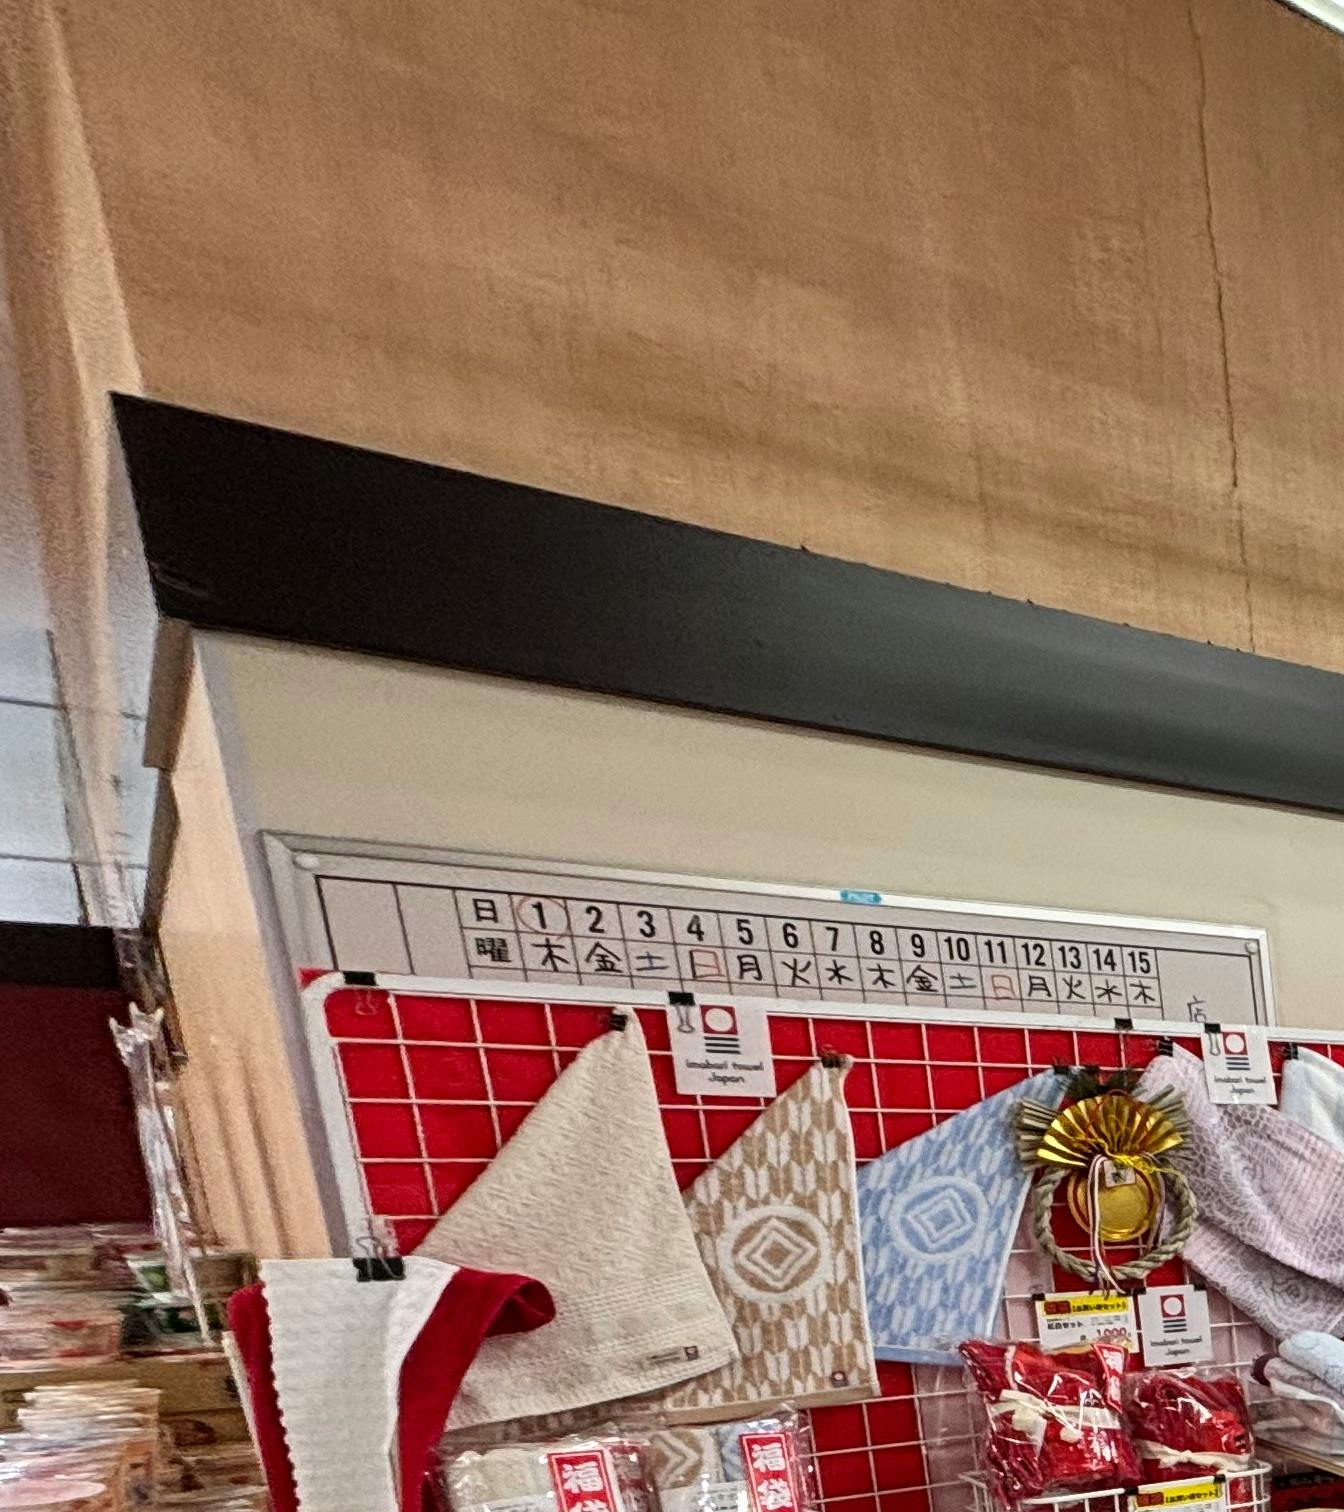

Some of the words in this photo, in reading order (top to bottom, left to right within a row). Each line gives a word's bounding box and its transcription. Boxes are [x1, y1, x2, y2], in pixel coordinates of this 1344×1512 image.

[474, 898, 499, 924] 日
[532, 902, 548, 930] 1
[586, 906, 605, 934] 2
[638, 910, 656, 938] 3
[687, 914, 704, 942] 4
[737, 918, 754, 945] 5
[782, 923, 799, 949] 6
[825, 926, 840, 952] 7
[869, 931, 884, 956] 8
[911, 933, 926, 958] 9
[944, 936, 972, 962] 10
[984, 940, 1008, 965] 11
[1021, 943, 1047, 969] 12
[1057, 945, 1083, 970] 13
[1092, 948, 1117, 973] 14
[1127, 950, 1152, 975] 15
[476, 936, 511, 964] 曜
[532, 938, 568, 971] 木
[585, 942, 622, 974] 金
[635, 951, 669, 972] 土
[690, 949, 726, 979] 日
[738, 955, 764, 981] 月
[781, 958, 812, 987] 火
[825, 960, 854, 986] 水
[867, 965, 896, 990] 木
[906, 965, 939, 992] 金
[949, 973, 977, 990] 土
[991, 975, 1018, 999] 日
[1028, 975, 1052, 998] 月
[1062, 976, 1086, 1000] 火
[1133, 979, 1159, 1004] 木
[686, 1059, 728, 1071] imabari
[731, 1061, 765, 1071] towel
[709, 1072, 745, 1086] Japan
[752, 1442, 795, 1511] 福袋
